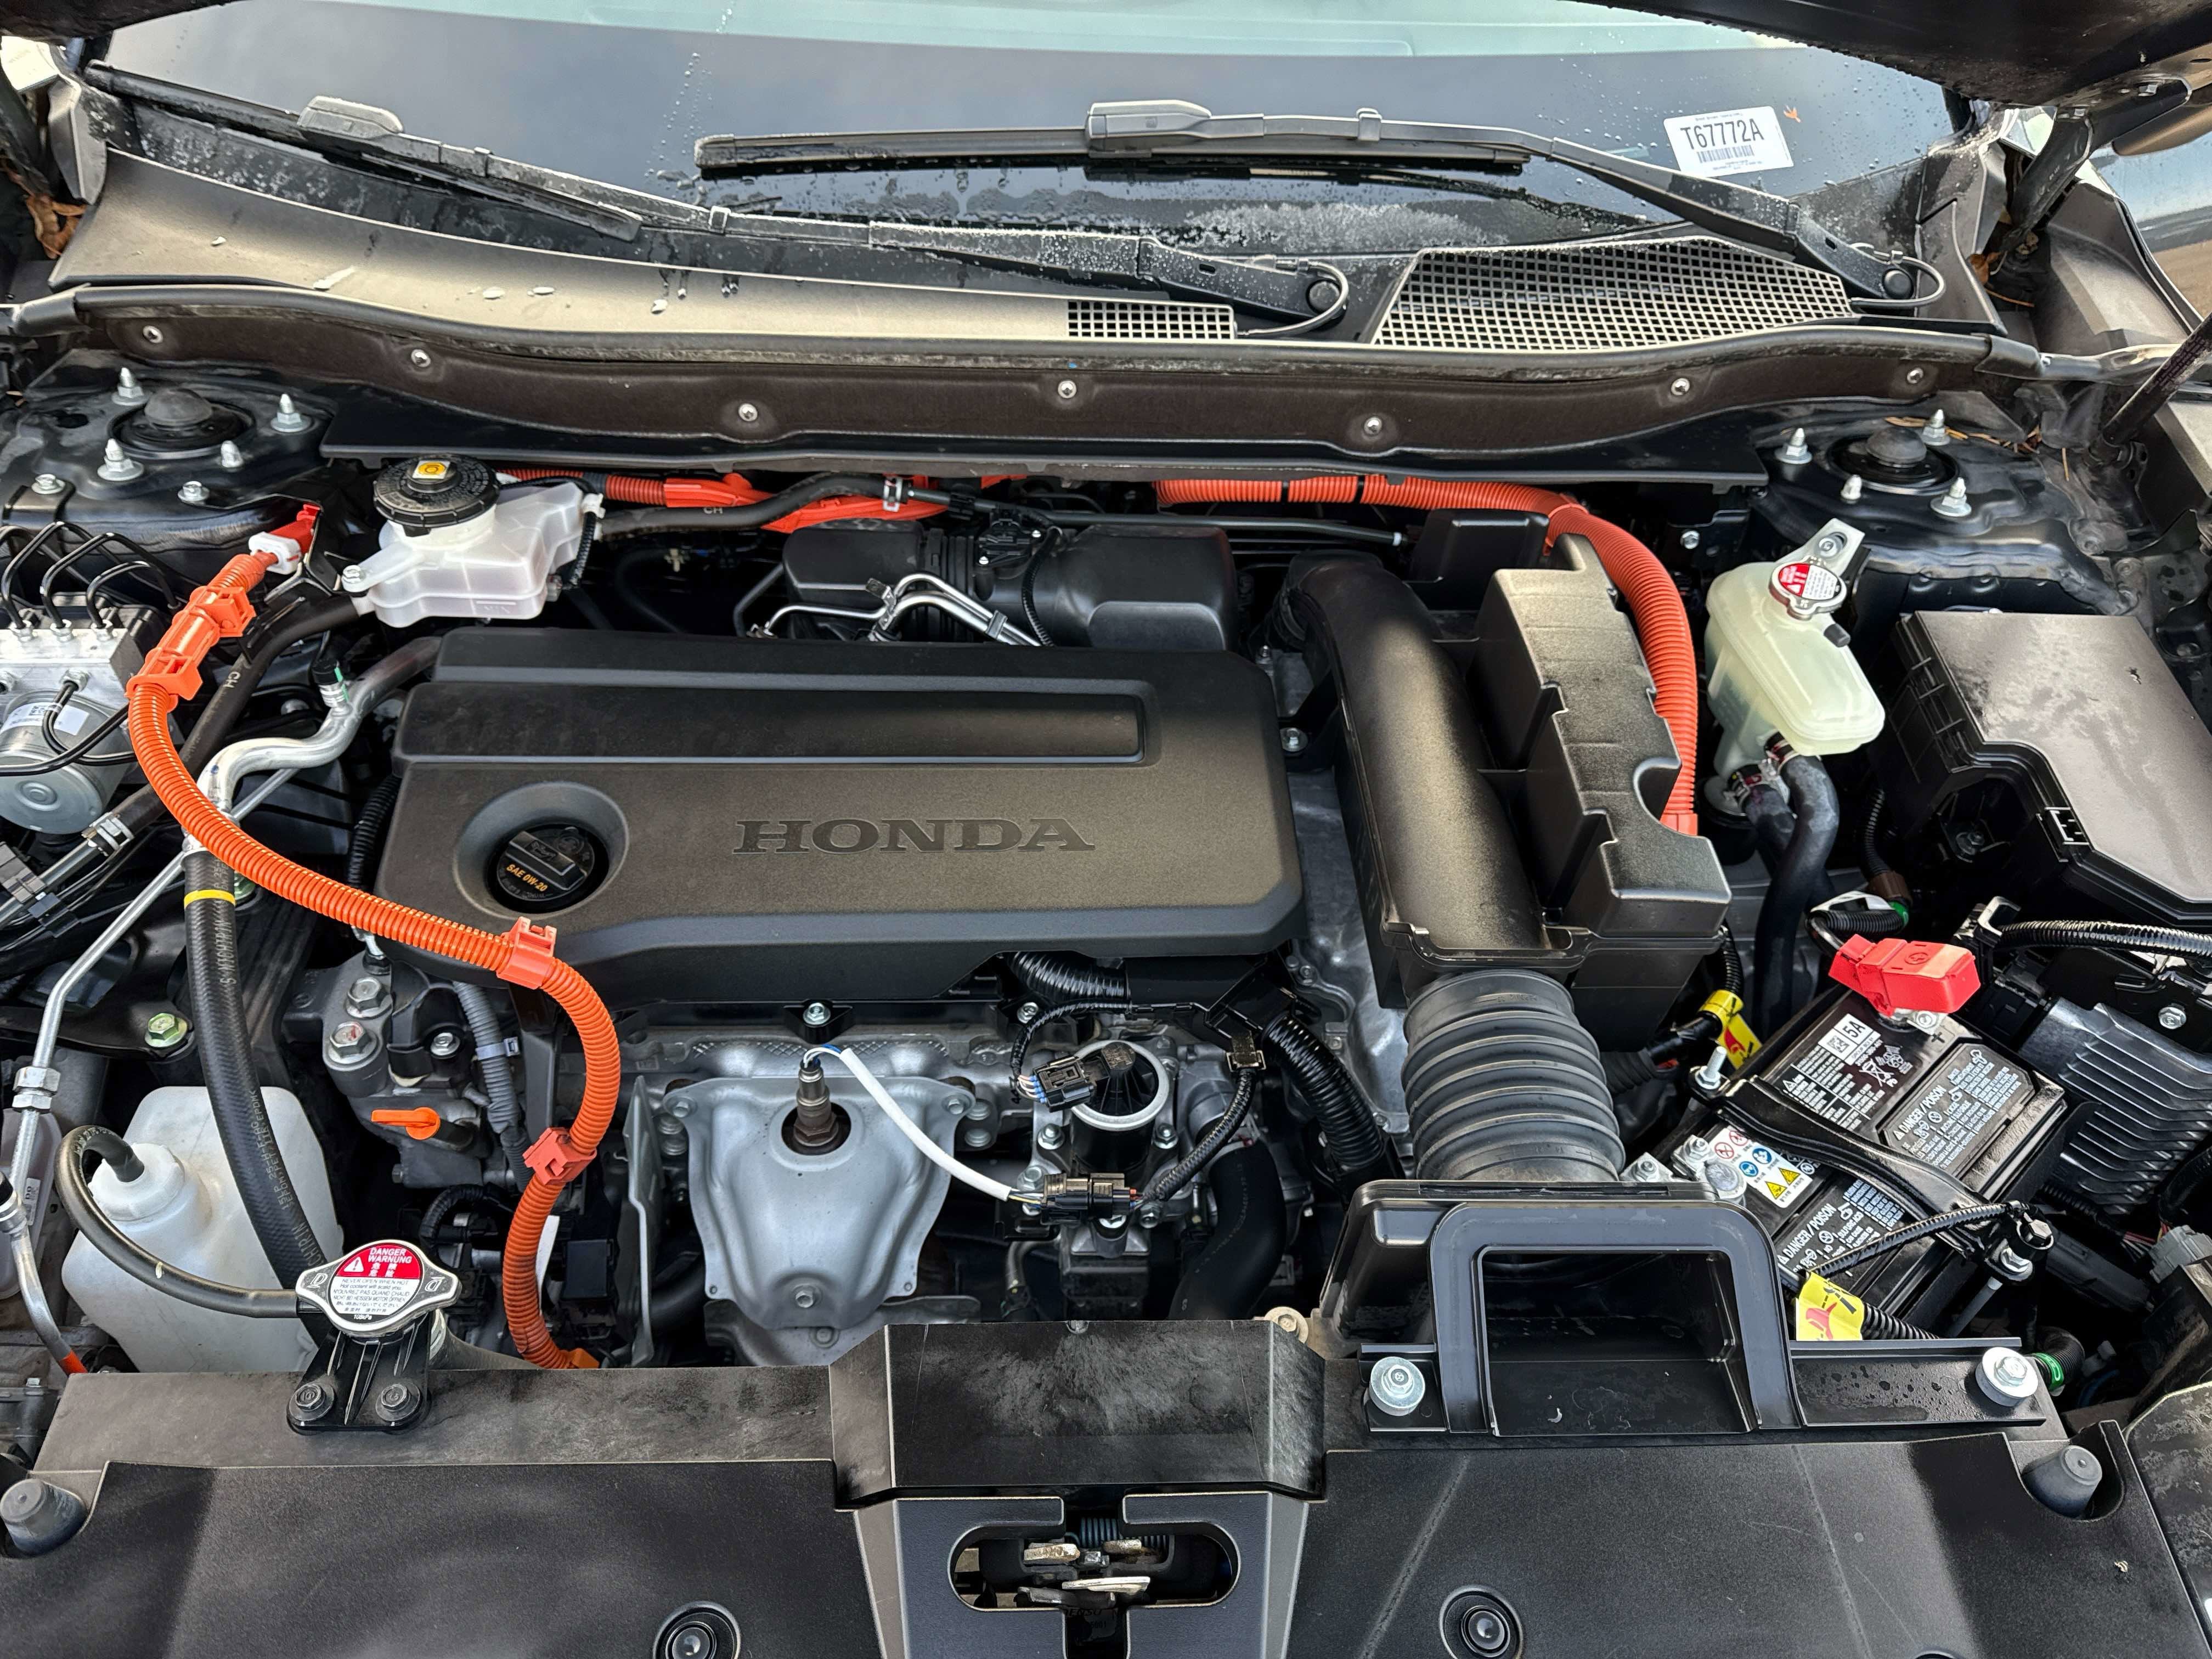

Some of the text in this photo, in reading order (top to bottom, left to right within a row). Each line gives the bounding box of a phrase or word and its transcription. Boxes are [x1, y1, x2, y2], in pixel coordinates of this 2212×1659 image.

[1680, 118, 1764, 149] T67772A
[732, 818, 1096, 854] HONDA
[506, 864, 524, 878] SAE
[523, 873, 548, 893] 0W-20
[1846, 1020, 1867, 1039] 5A
[368, 1255, 413, 1264] WARNUNG
[369, 1247, 407, 1256] DANGER
